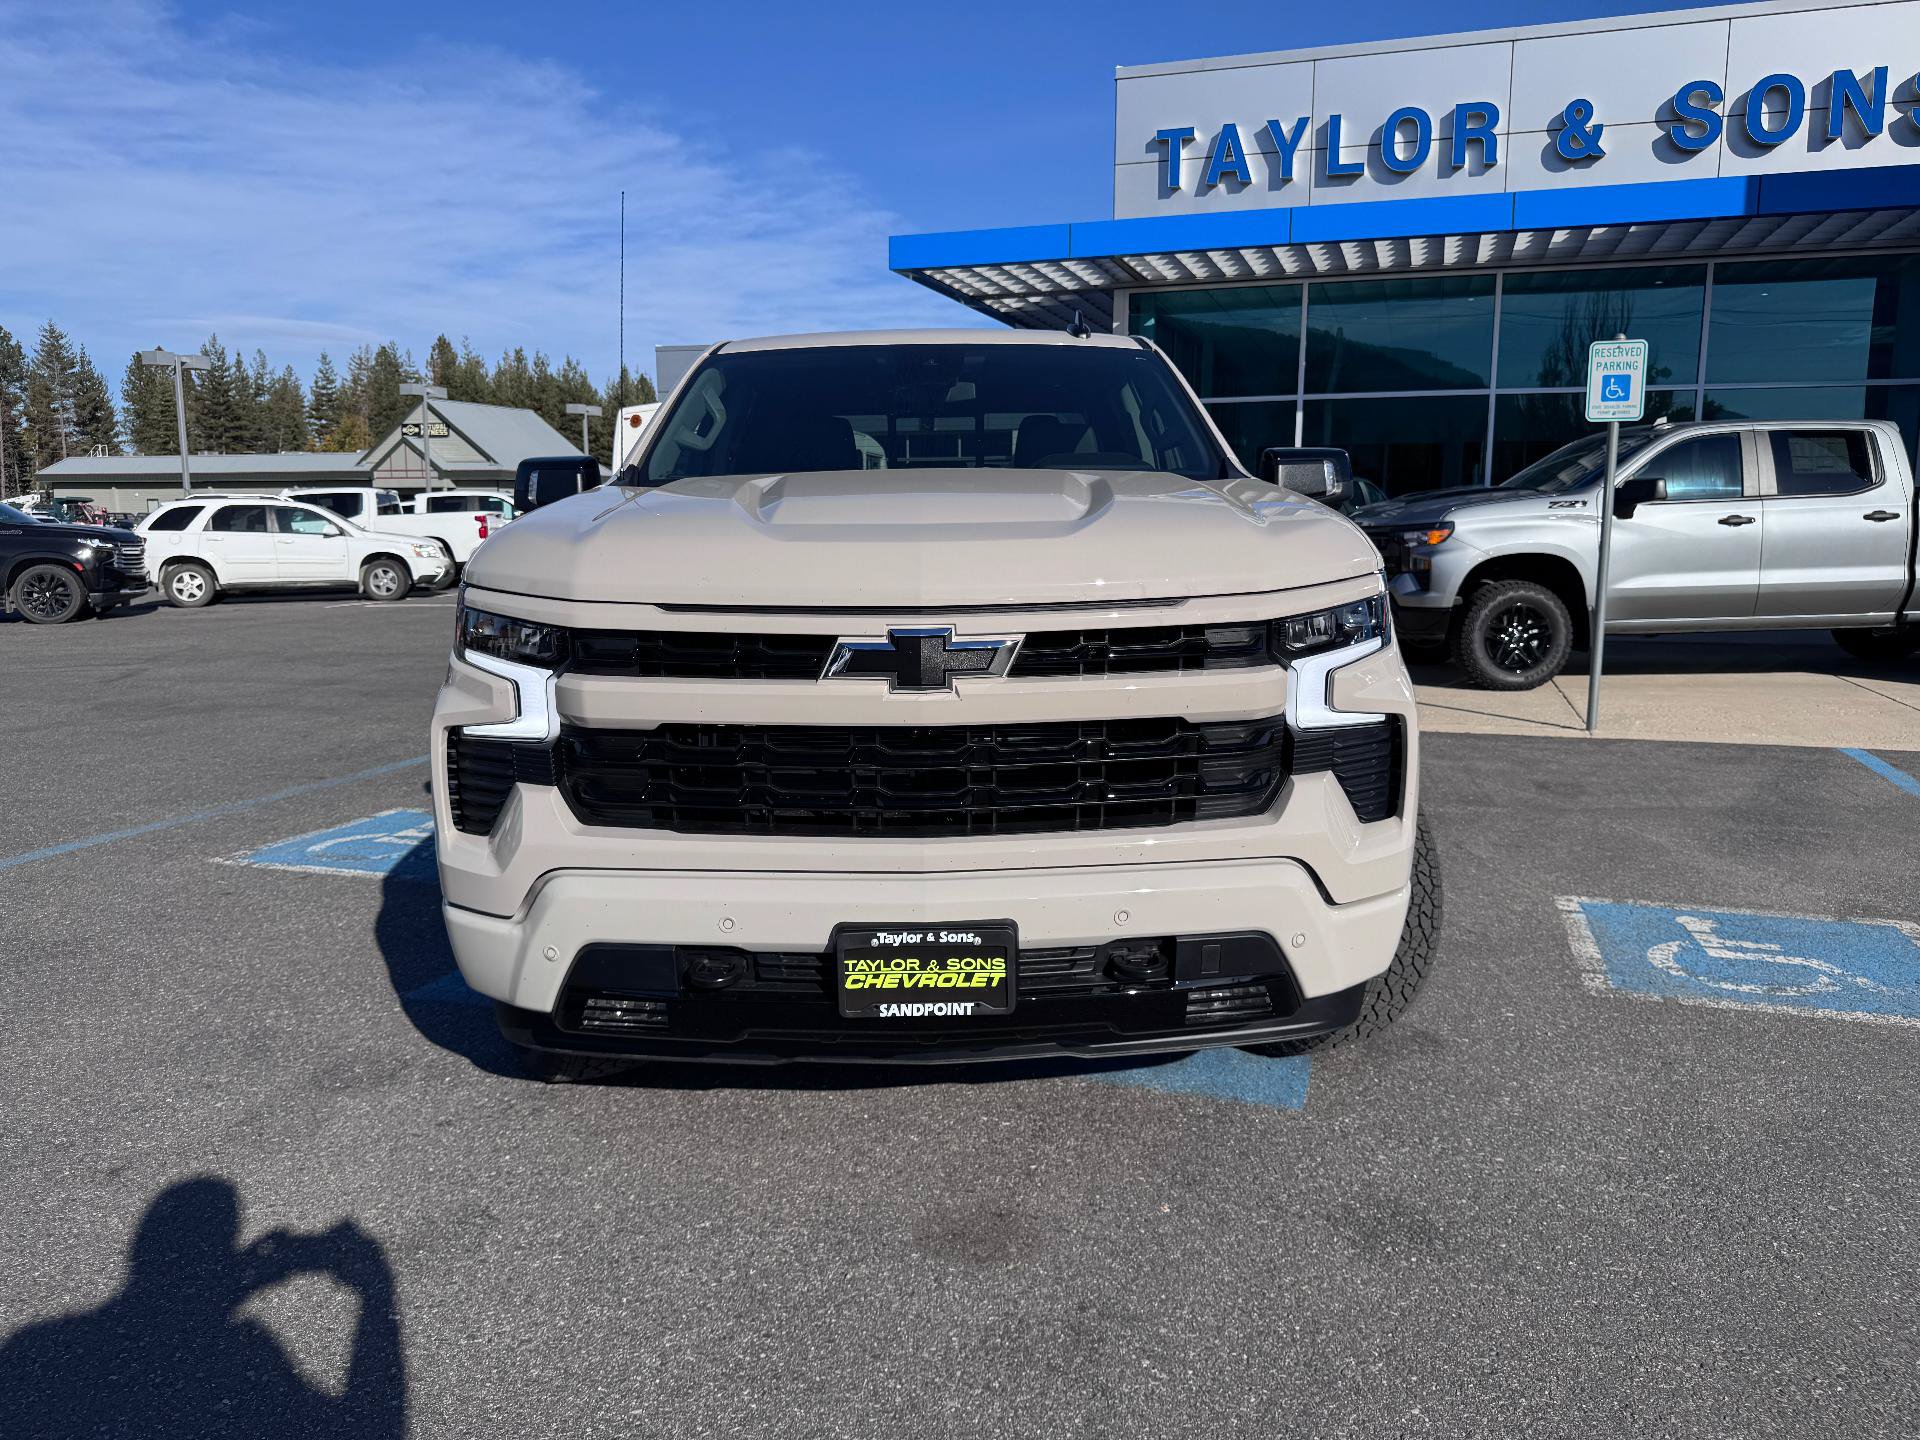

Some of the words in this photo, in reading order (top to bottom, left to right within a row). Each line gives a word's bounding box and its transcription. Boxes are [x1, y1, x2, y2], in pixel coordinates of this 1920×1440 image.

[1155, 101, 1500, 189] TAYLOR
[1556, 97, 1606, 160] &
[1670, 65, 1920, 151] SON
[1594, 347, 1642, 358] RESERVED
[1596, 360, 1639, 372] PARKING
[876, 931, 923, 947] Taylor
[926, 932, 936, 943] &
[939, 931, 975, 943] Sons
[844, 958, 920, 972] TAYLOR
[926, 959, 940, 973] &
[947, 957, 1006, 970] SONS
[844, 972, 1007, 990] CHEVROLET
[879, 1002, 975, 1017] SANDPOINT
